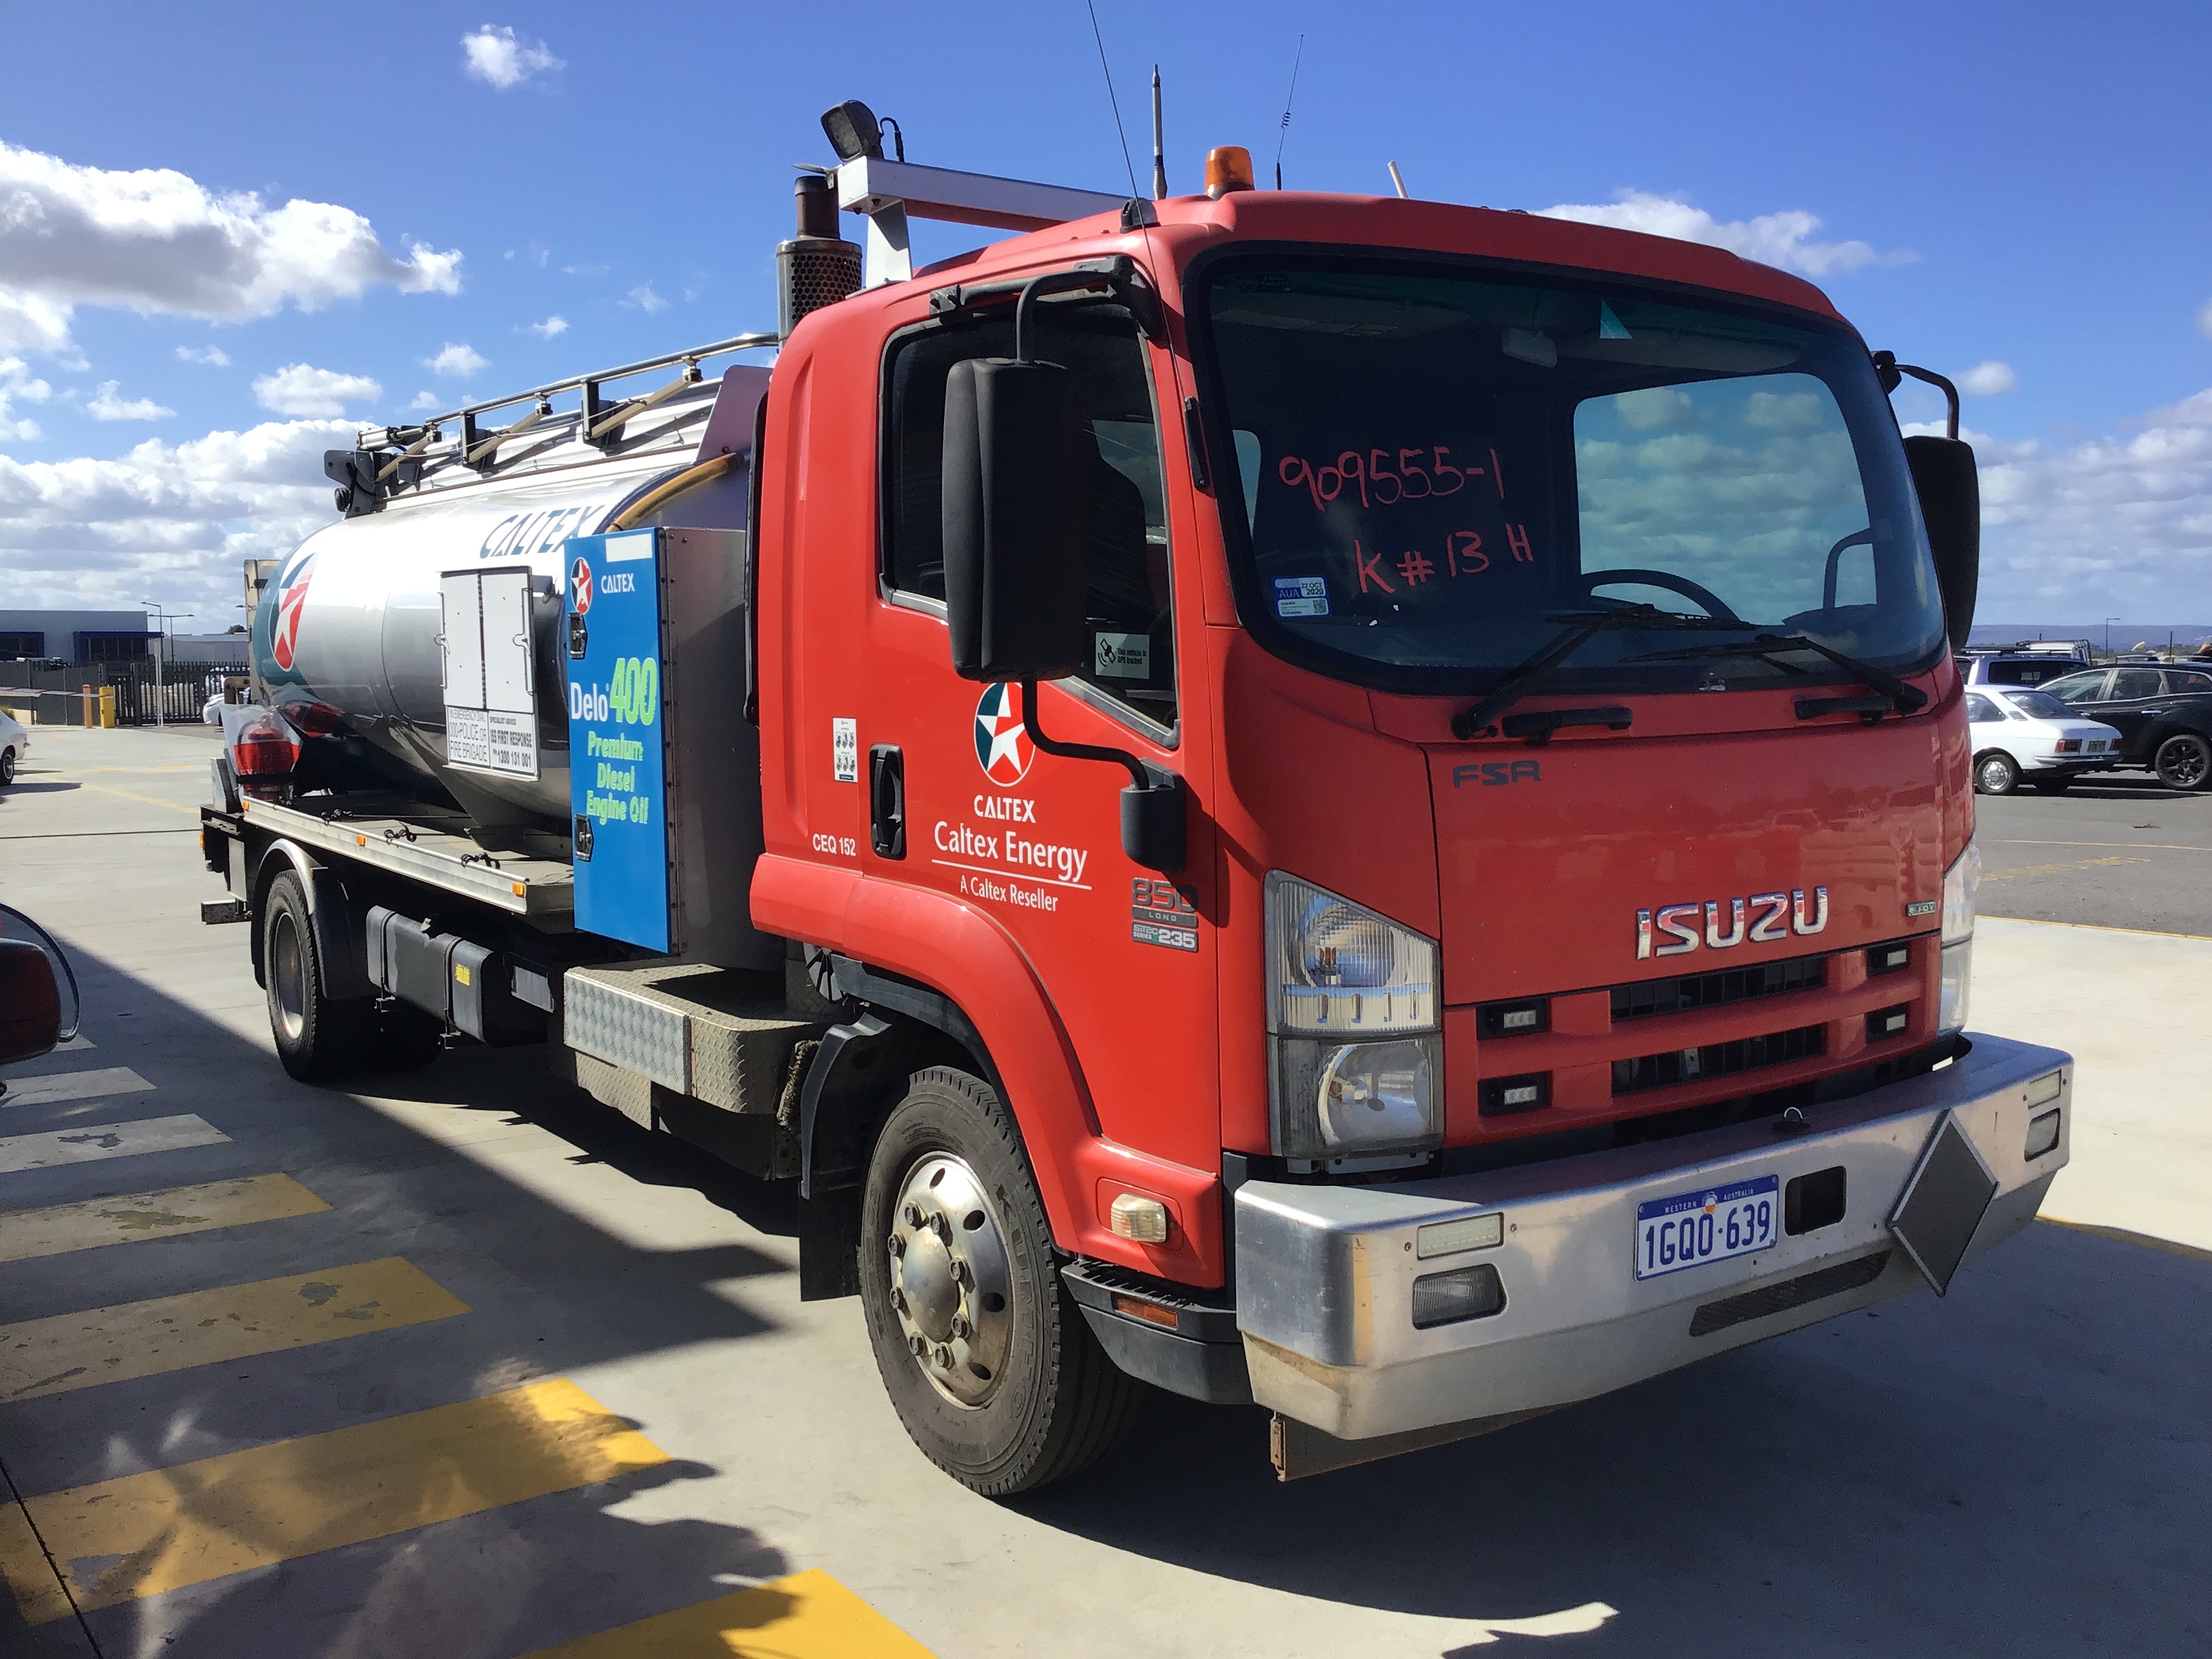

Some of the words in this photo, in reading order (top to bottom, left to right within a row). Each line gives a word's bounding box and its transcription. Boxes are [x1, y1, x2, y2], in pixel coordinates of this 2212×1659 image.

[1278, 446, 1504, 512] 909555-1
[480, 505, 606, 559] CALTEX
[1506, 523, 1534, 562] H
[600, 573, 636, 594] CALTEX
[1279, 588, 1300, 598] AUA
[1306, 588, 1324, 596] 2020
[570, 682, 609, 722] Delo
[610, 657, 657, 726] 400
[462, 742, 488, 762] BRIGADE
[497, 730, 509, 745] FIRST
[510, 731, 532, 748] RESPONSE
[588, 731, 643, 762] Premium
[511, 751, 520, 766] 131
[522, 752, 531, 768] 001
[1453, 760, 1541, 788] FSR
[597, 762, 636, 792] Diesel
[586, 790, 627, 825] Engine
[630, 796, 649, 824] Oil
[974, 794, 1036, 823] CALTEX
[813, 833, 837, 854] CEQ
[838, 837, 856, 857] 152
[935, 821, 998, 859] Caltex
[1006, 831, 1088, 883] Energy
[960, 874, 968, 895] A
[970, 876, 1006, 902] Caltex
[1010, 884, 1059, 912] Reseller
[1132, 877, 1199, 913] 850
[1149, 911, 1177, 922] LONG
[1636, 885, 1829, 960] ISUZU
[1158, 928, 1195, 948] 235
[1664, 1200, 1697, 1213] WESTERN
[1723, 1188, 1754, 1200] AUSTRALIA
